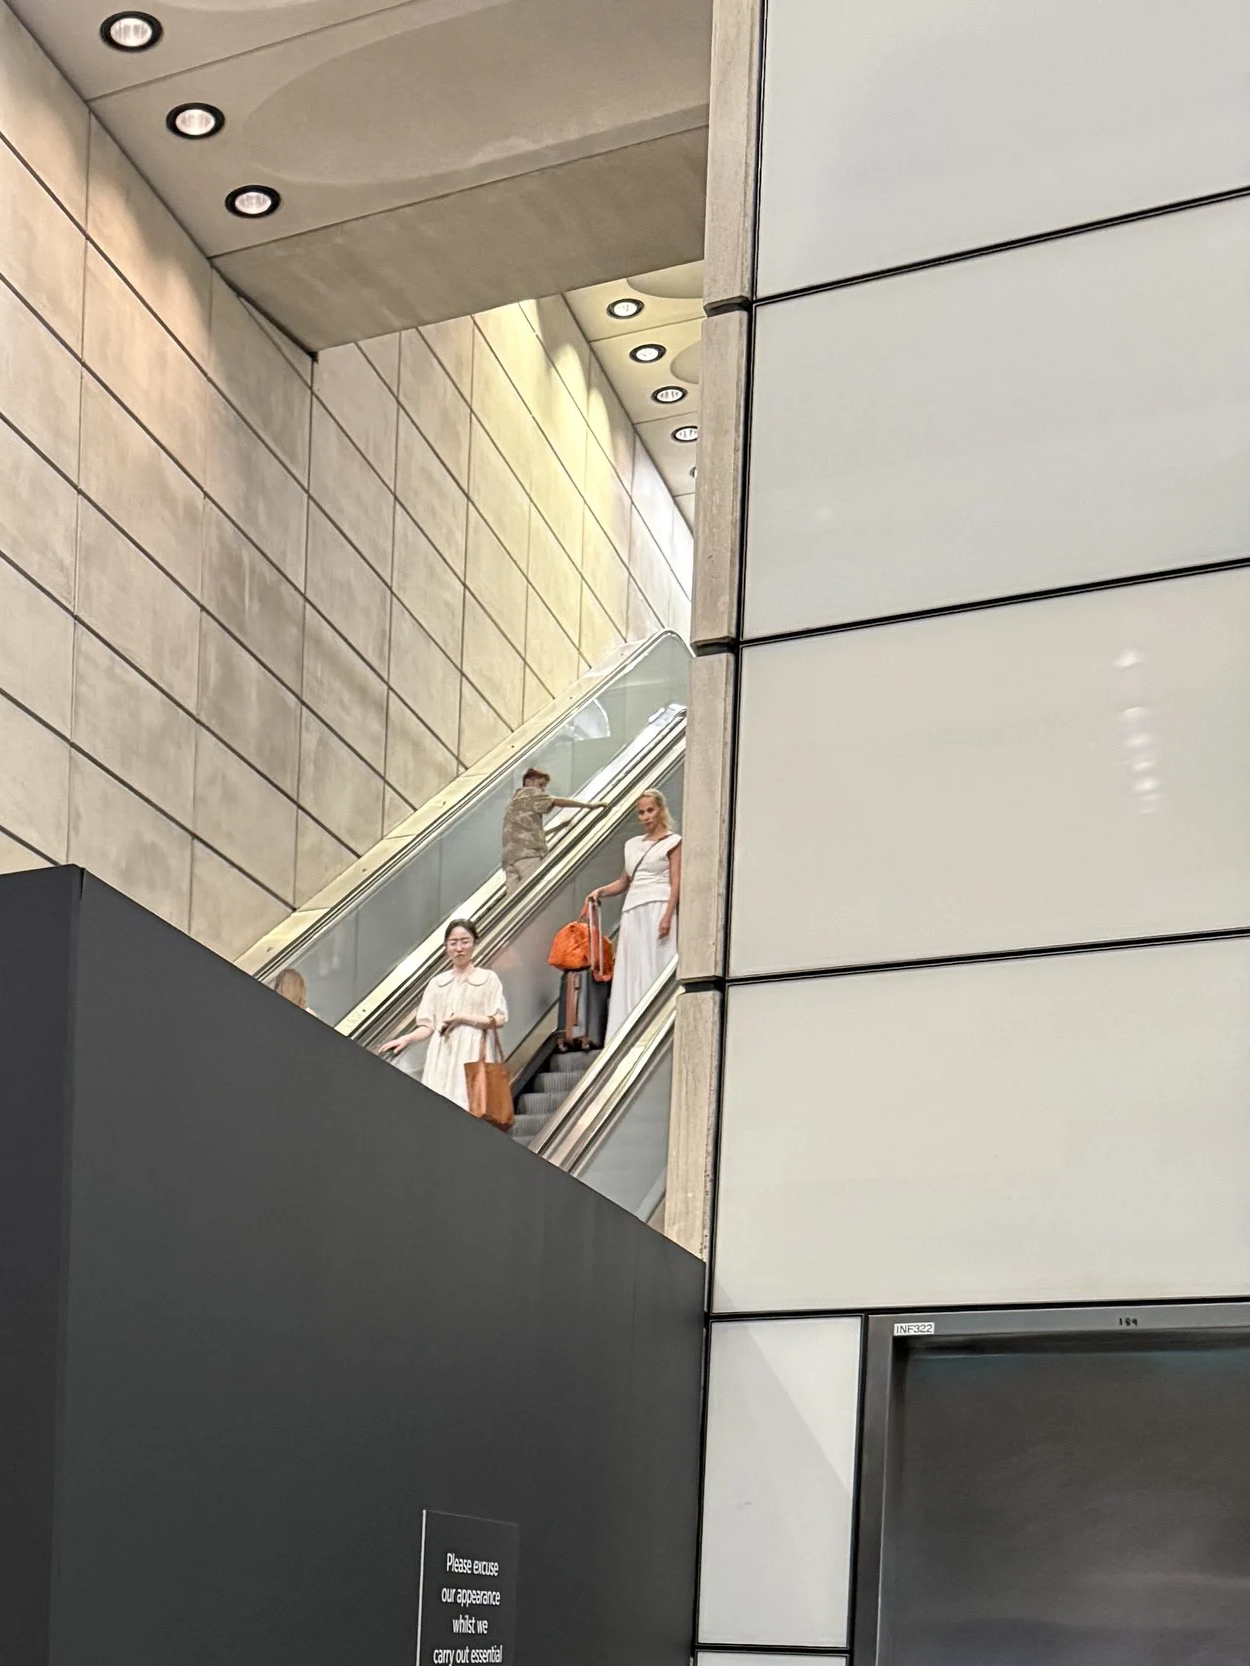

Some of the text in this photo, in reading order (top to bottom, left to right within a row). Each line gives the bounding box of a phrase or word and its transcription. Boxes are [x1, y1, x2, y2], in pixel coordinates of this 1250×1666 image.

[896, 1323, 933, 1334] INF322
[446, 1552, 499, 1577] Please excuse
[441, 1587, 500, 1606] our appearance
[452, 1614, 488, 1634] whilst we
[455, 1648, 470, 1665] out
[471, 1645, 502, 1663] essential
